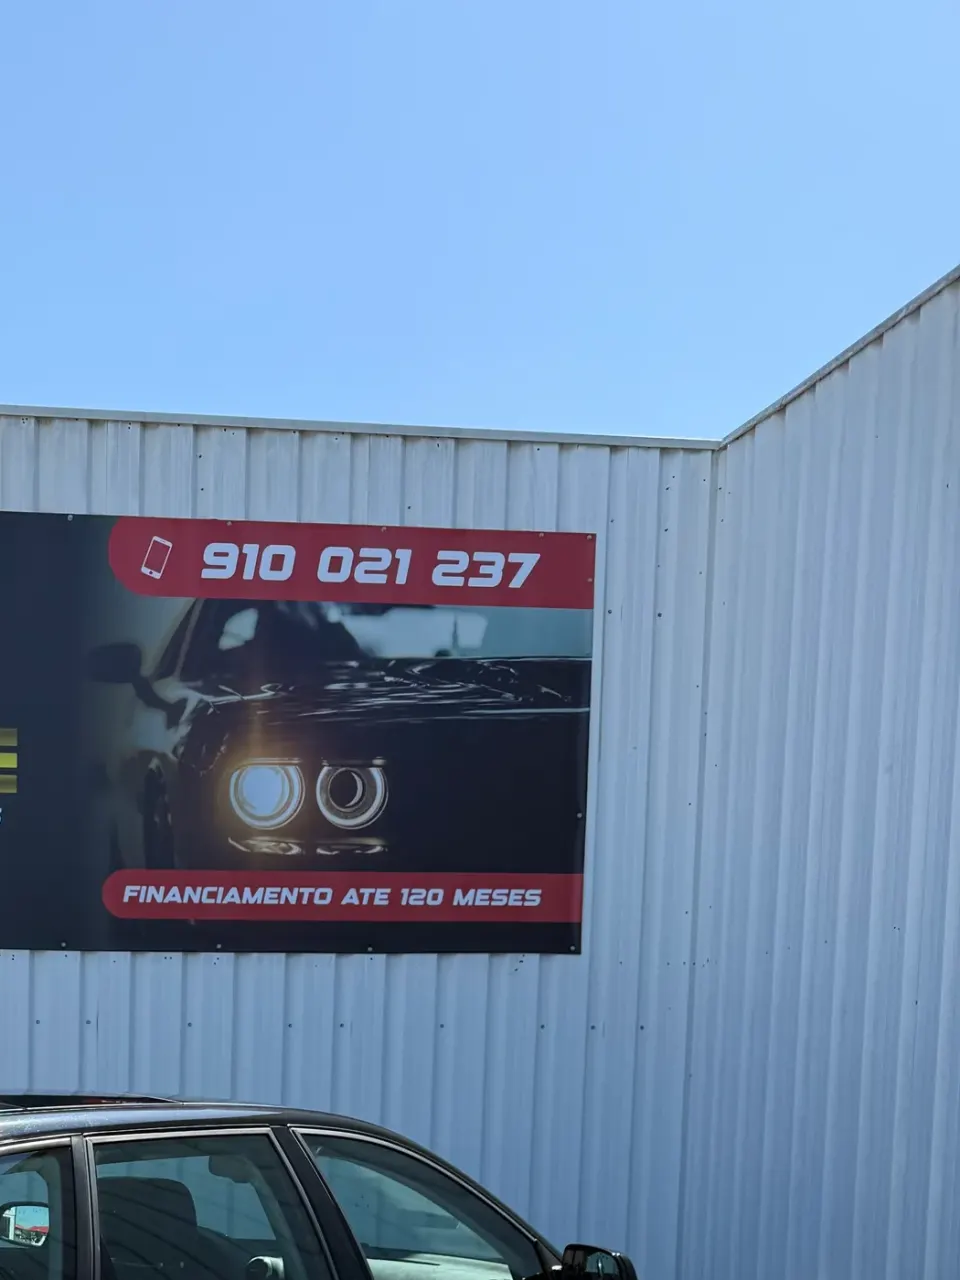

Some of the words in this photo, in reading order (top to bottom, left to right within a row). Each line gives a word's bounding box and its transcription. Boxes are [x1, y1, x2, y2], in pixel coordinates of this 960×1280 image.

[201, 542, 296, 582] 910
[317, 547, 413, 585] 021
[431, 550, 541, 589] 237
[123, 885, 334, 907] FINANCIAMENTO
[340, 887, 391, 907] ATE
[401, 889, 444, 907] 120
[452, 889, 542, 908] MESES
